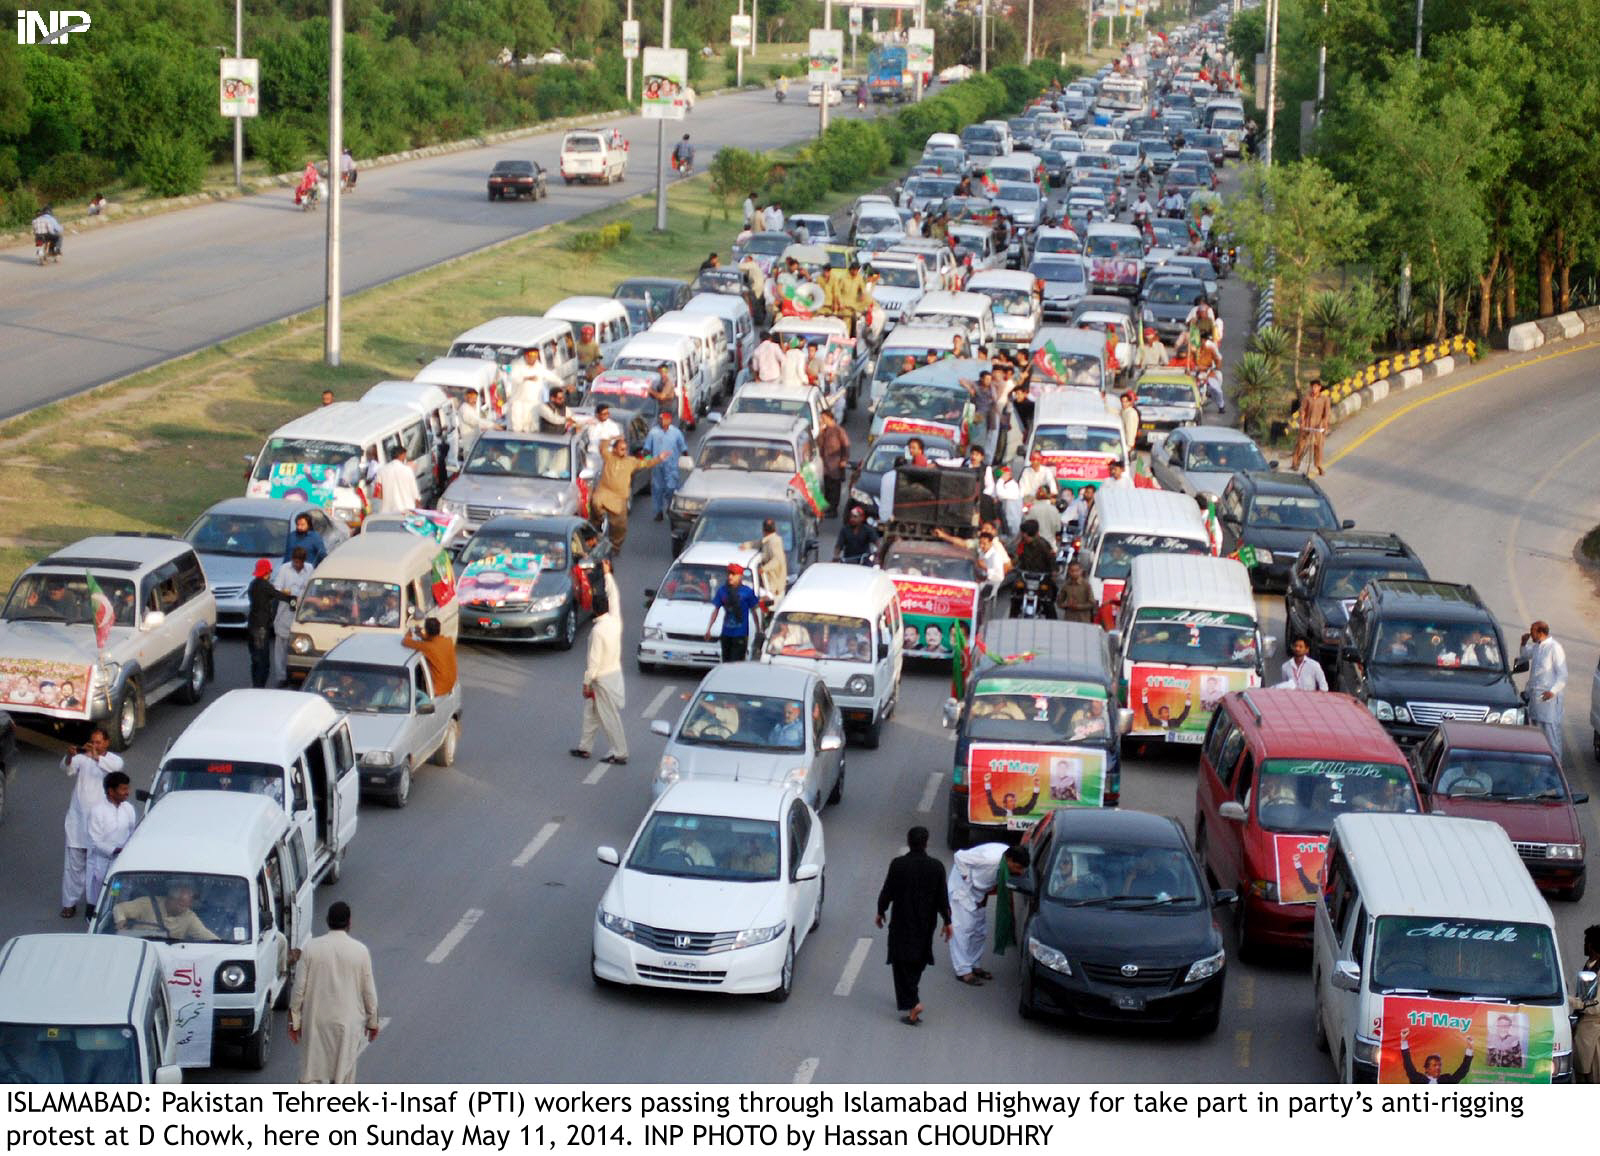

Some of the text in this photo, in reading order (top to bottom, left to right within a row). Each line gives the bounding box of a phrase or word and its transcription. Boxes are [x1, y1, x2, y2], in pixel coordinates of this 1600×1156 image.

[1008, 759, 1041, 776] May
[1290, 761, 1383, 778] Allah
[1432, 1012, 1473, 1033] May
